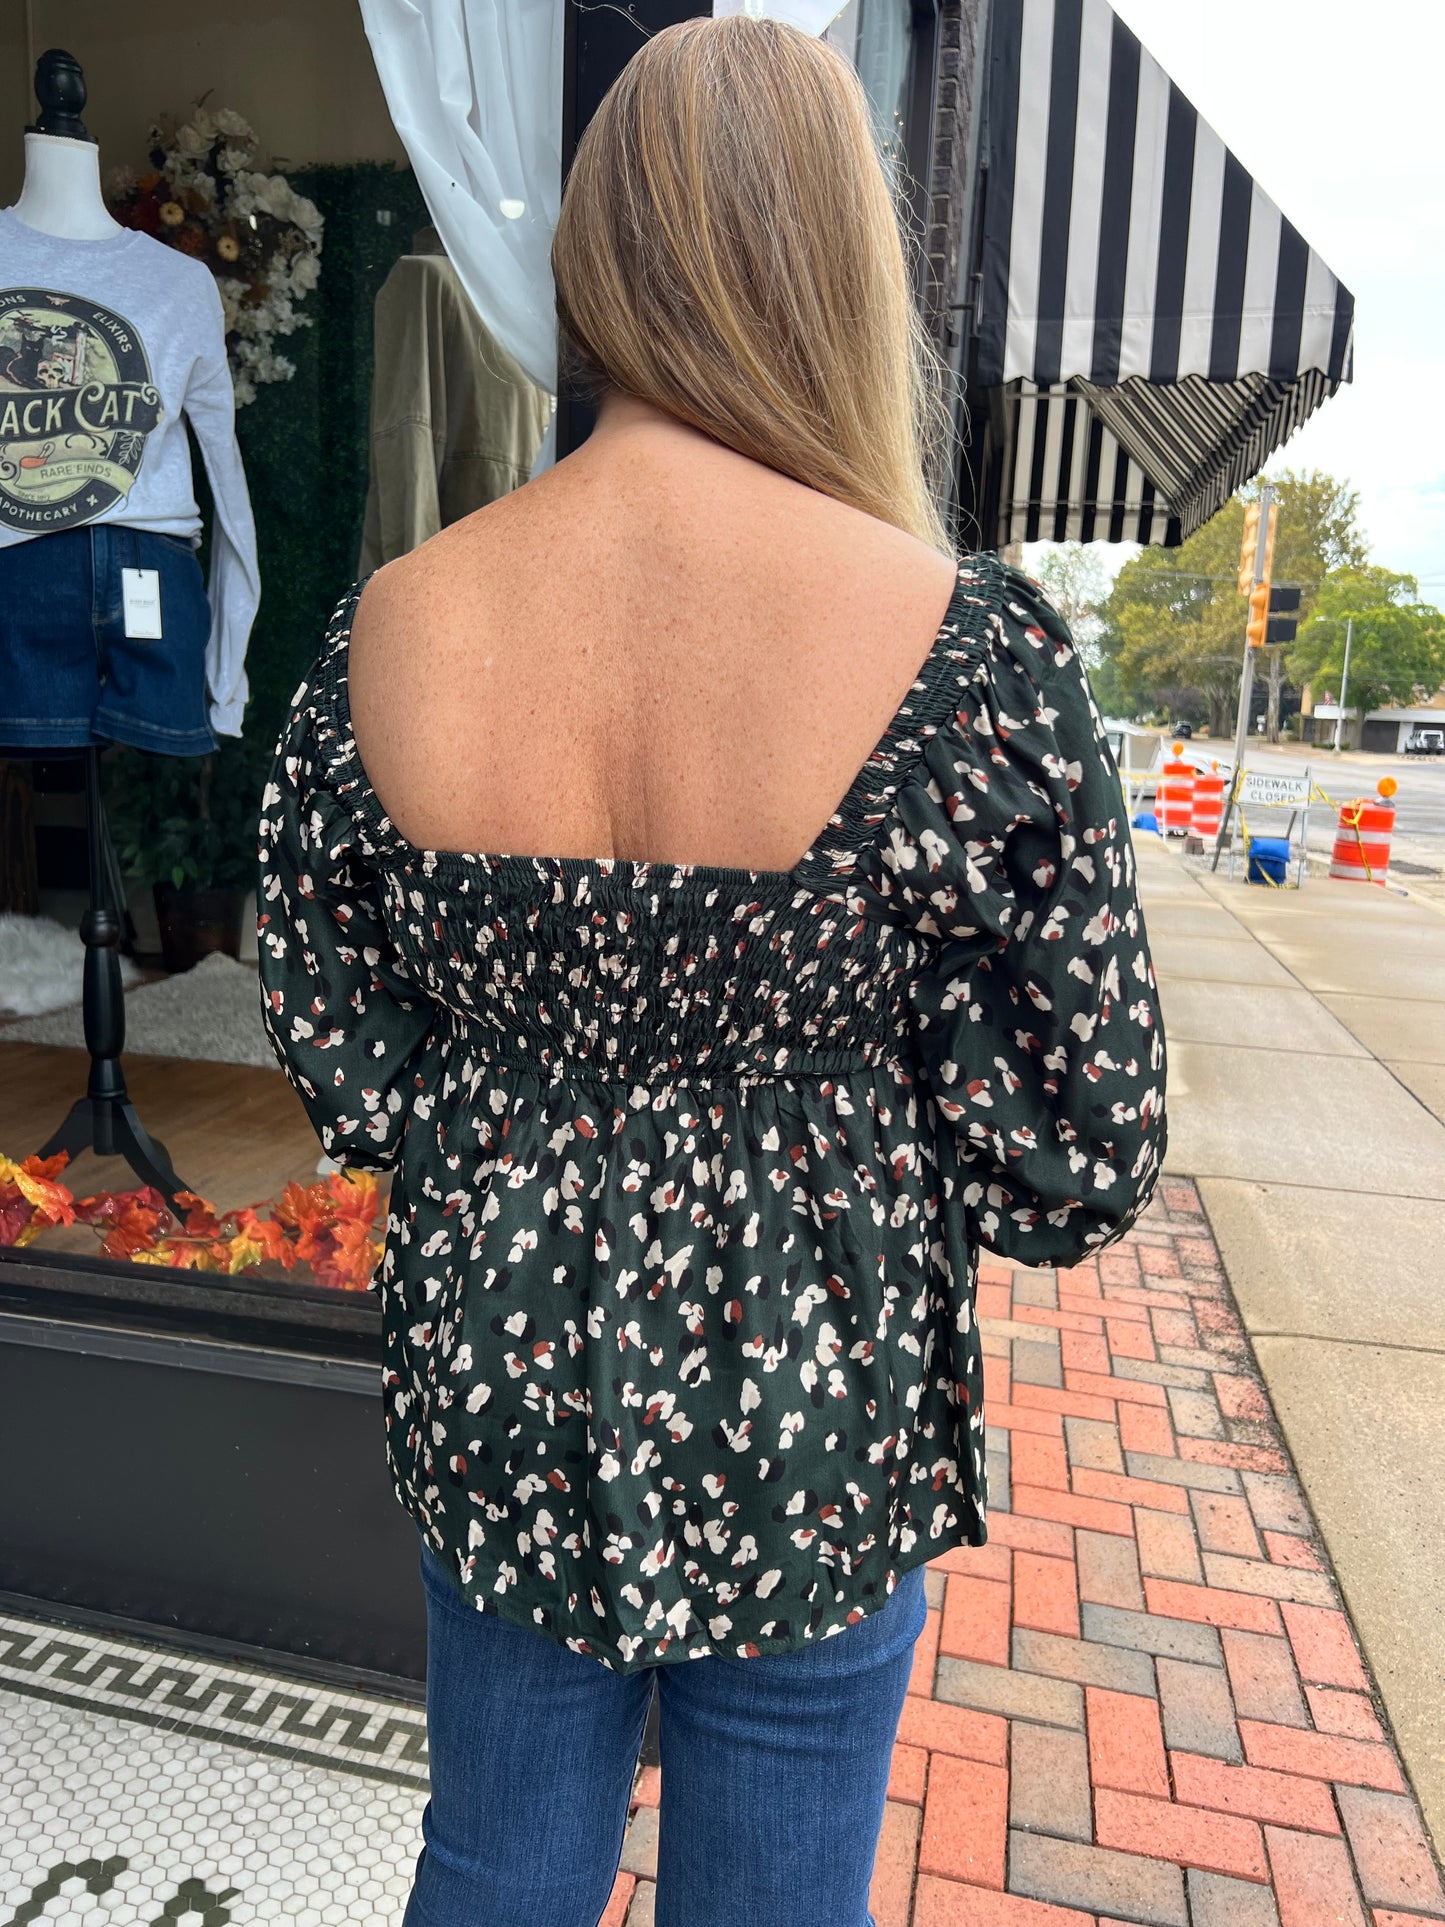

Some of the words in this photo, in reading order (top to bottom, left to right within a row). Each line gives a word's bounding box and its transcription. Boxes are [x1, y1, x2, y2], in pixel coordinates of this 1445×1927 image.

[93, 312, 132, 353] ELIXIRS
[40, 465, 73, 479] RARE
[76, 463, 112, 477] FINDS
[1246, 776, 1303, 792] SIDEWALK
[1250, 790, 1296, 803] CLOSED
